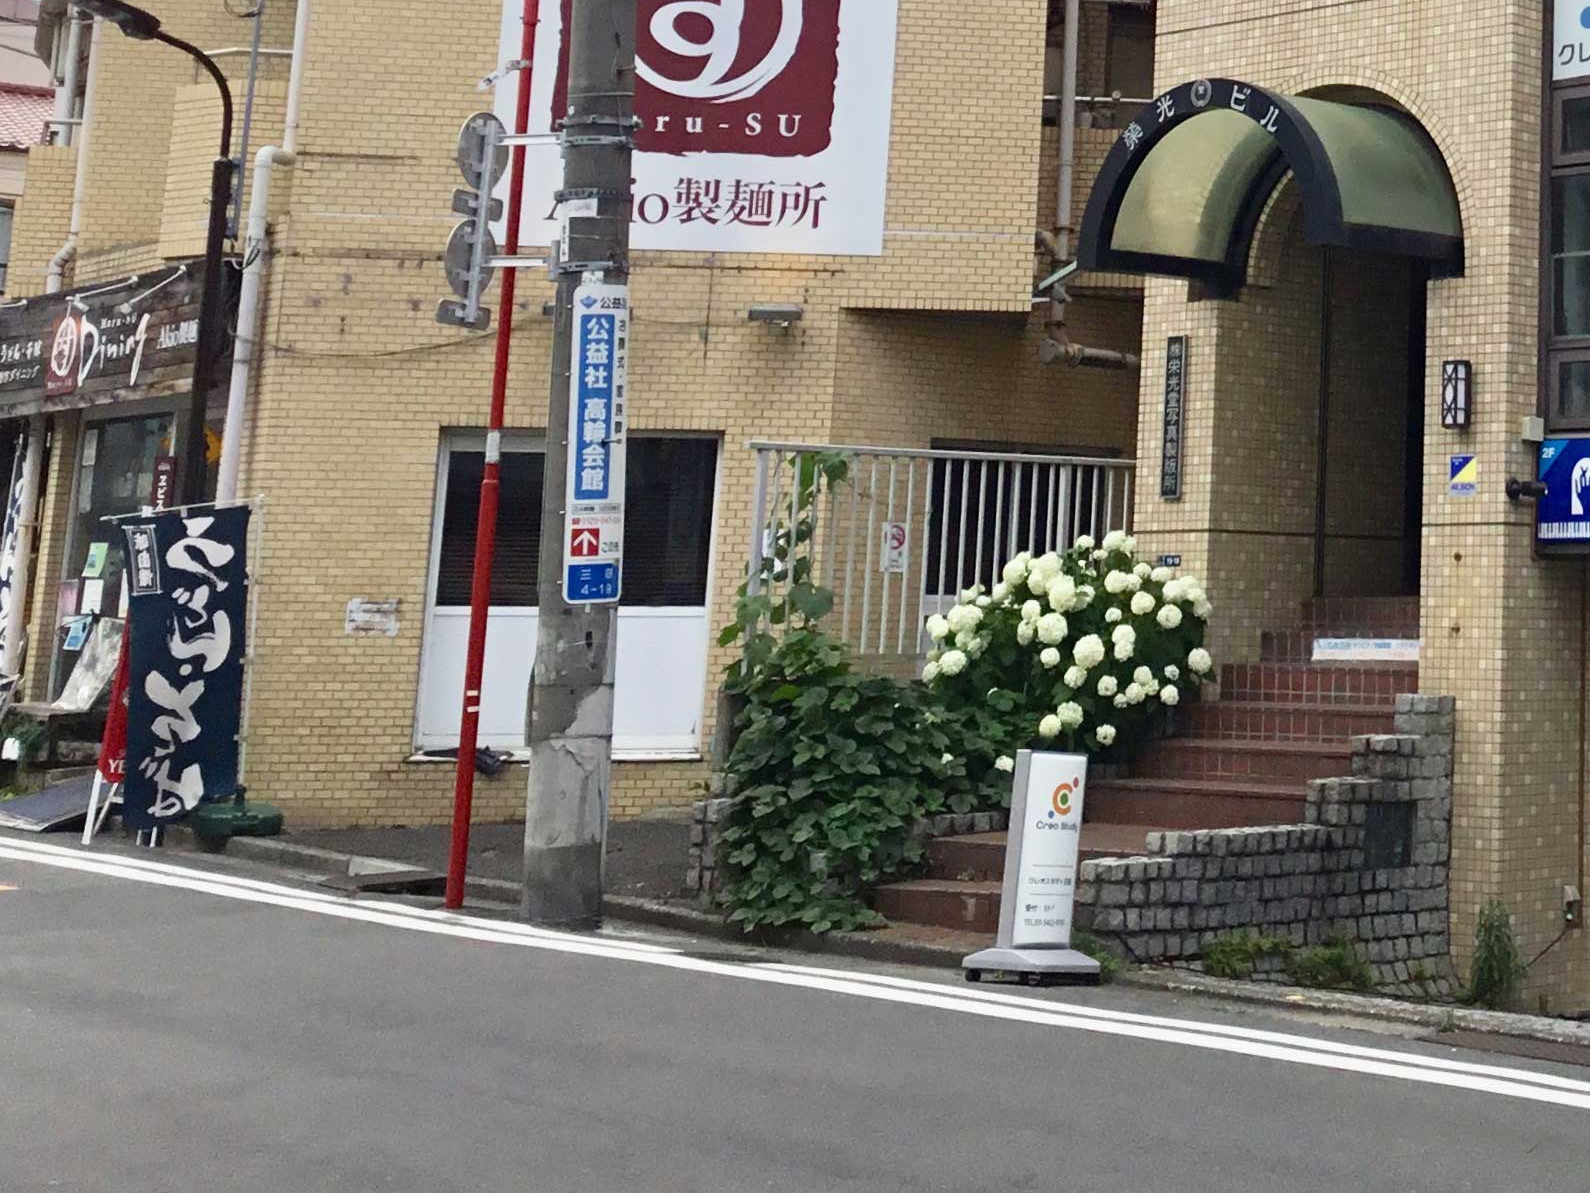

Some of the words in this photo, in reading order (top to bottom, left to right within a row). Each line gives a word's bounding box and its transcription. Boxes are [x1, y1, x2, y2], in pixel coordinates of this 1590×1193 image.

[77, 313, 151, 388] Dining
[584, 317, 610, 389] 公益社
[1541, 447, 1556, 459] 2F
[1036, 820, 1059, 831] Creo
